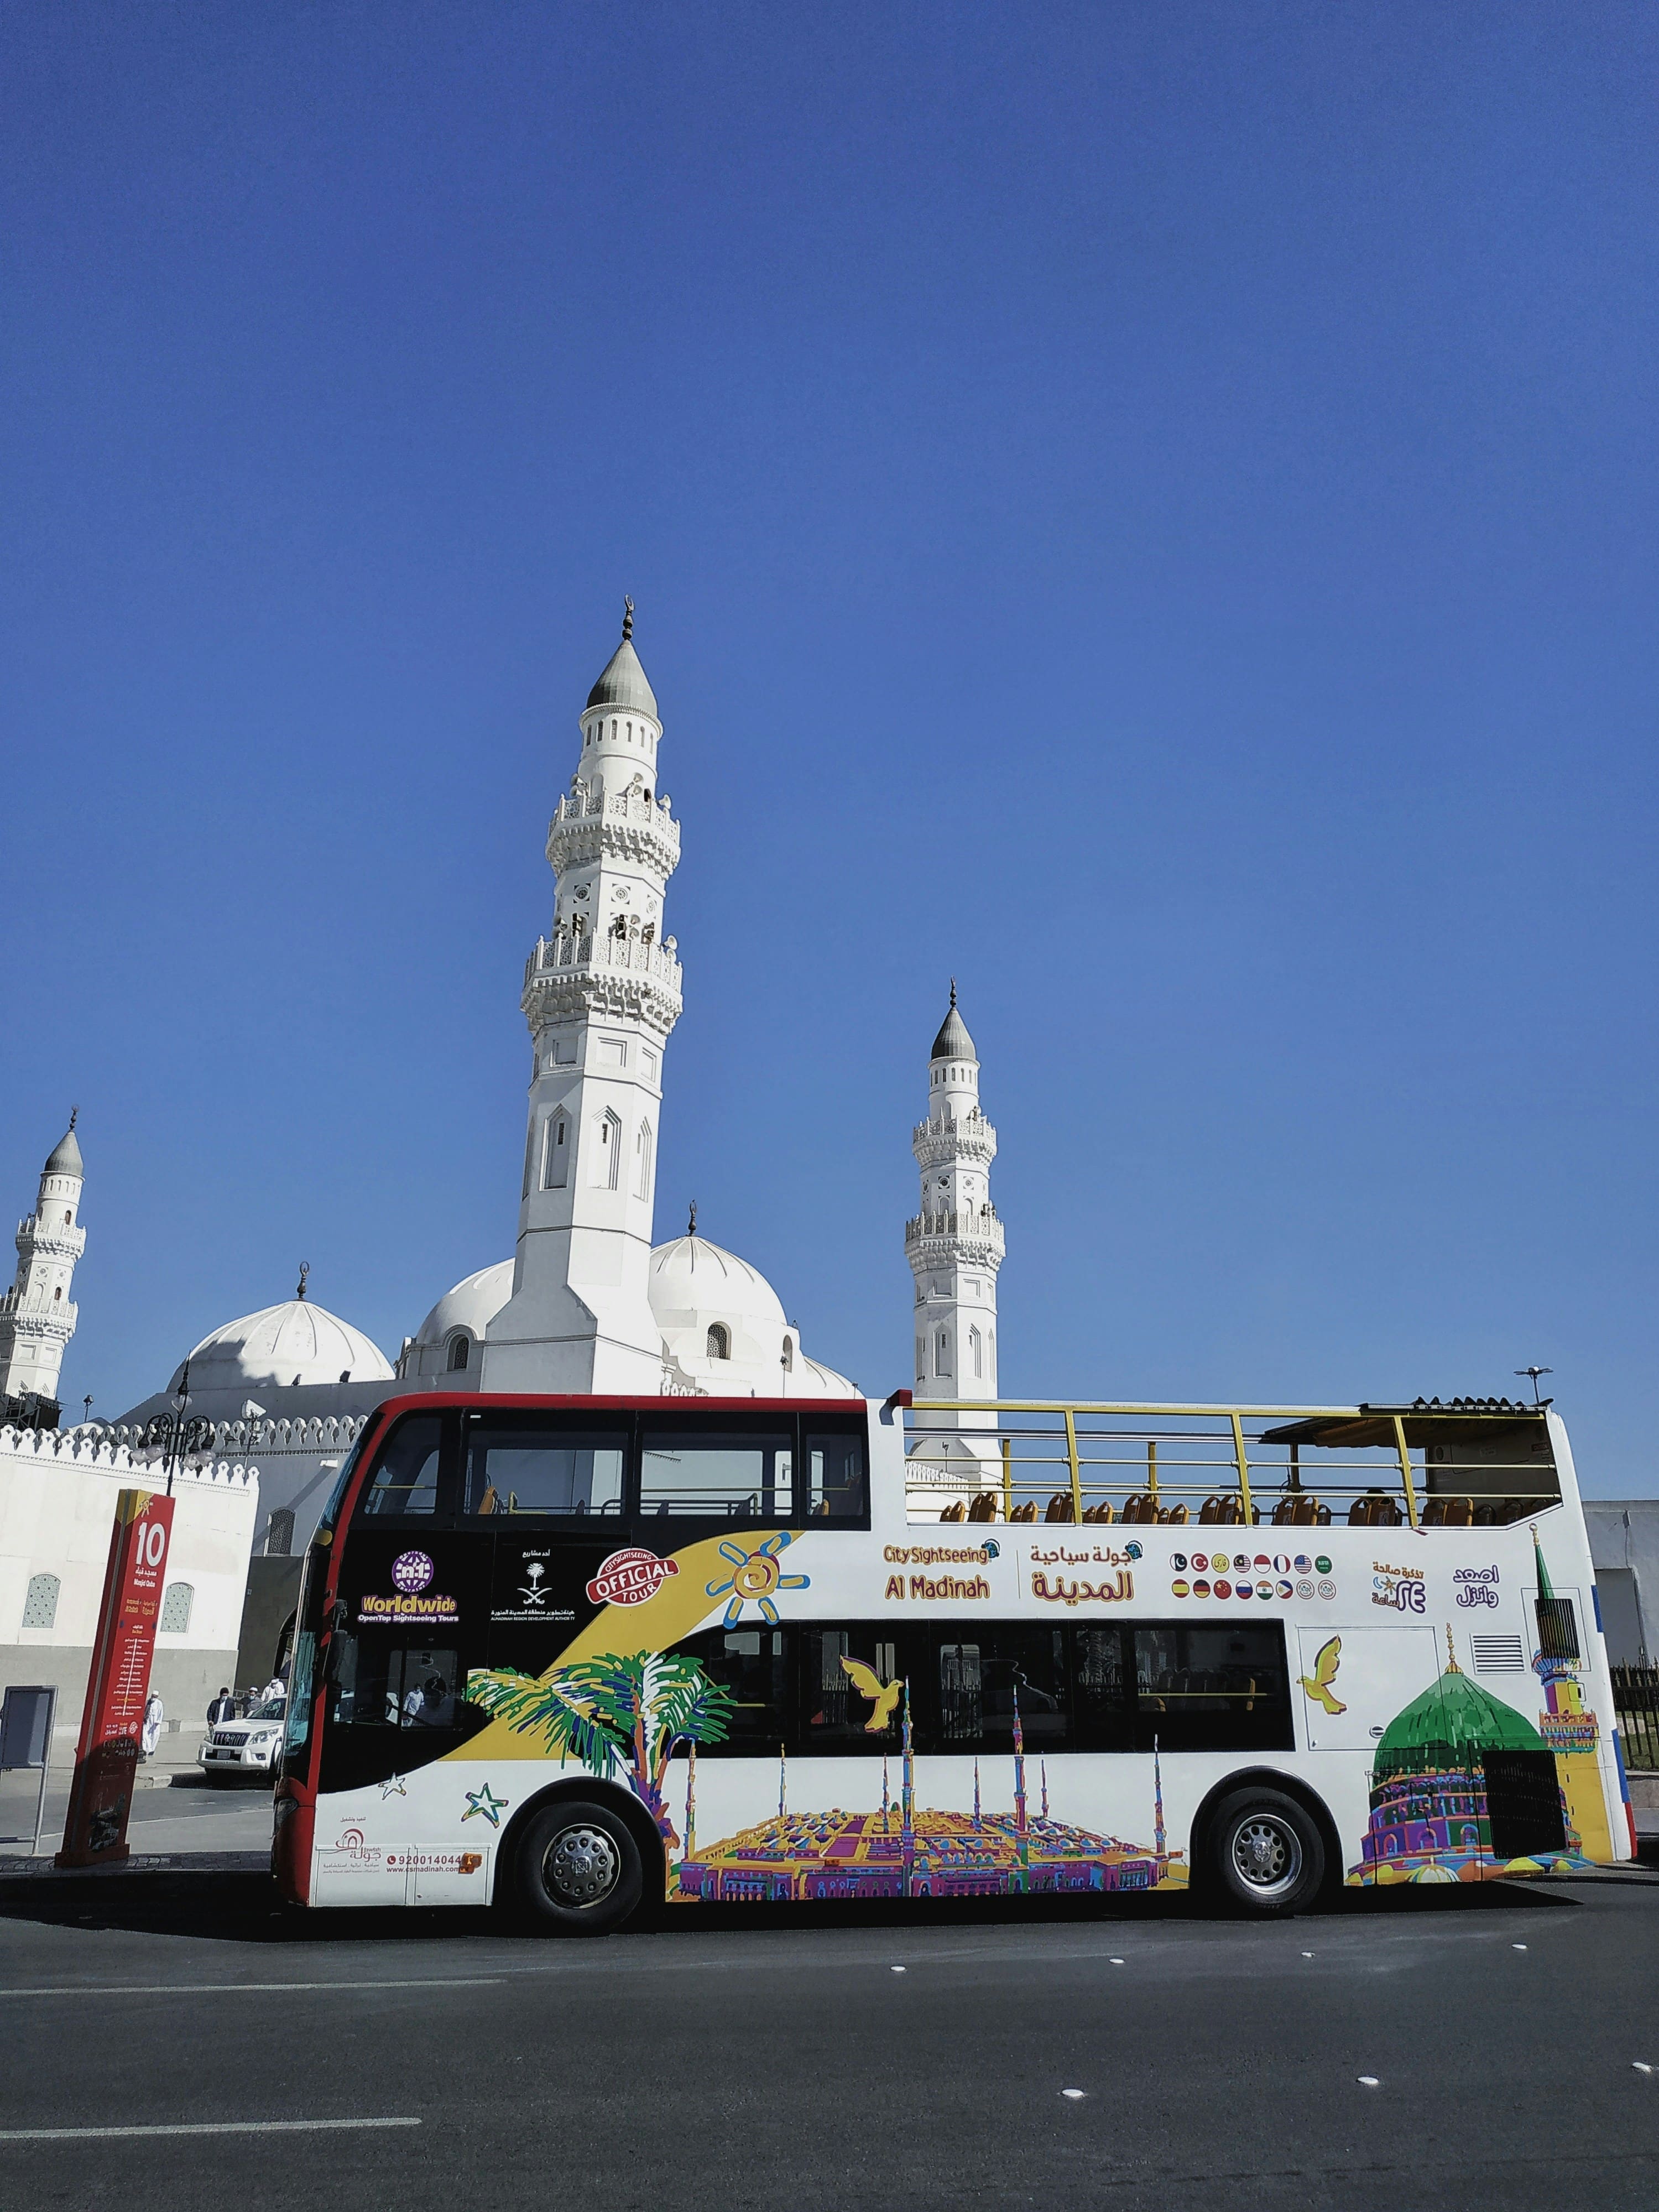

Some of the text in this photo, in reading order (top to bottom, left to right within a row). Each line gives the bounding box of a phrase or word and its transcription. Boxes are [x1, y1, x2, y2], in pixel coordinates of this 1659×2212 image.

[135, 1522, 165, 1567] 10
[522, 1550, 541, 1558] مشاريع
[605, 1552, 652, 1572] CITYSIGHTSEEING
[884, 1545, 989, 1565] City Sightseeing
[1030, 1545, 1132, 1567] جولة سياحية
[596, 1561, 674, 1597] OFFICIAL
[1373, 1561, 1425, 1579] تذكرة صالحة
[1453, 1564, 1499, 1583] اصعد
[623, 1583, 657, 1601] TOUR
[885, 1574, 990, 1599] Al Madinah
[1032, 1571, 1134, 1606] المدينة
[363, 1595, 456, 1614] Worldwide
[1372, 1592, 1400, 1608] ساعة
[1457, 1585, 1499, 1608] وانزل
[349, 1846, 381, 1862] جولة
[399, 1855, 462, 1864] 920014044
